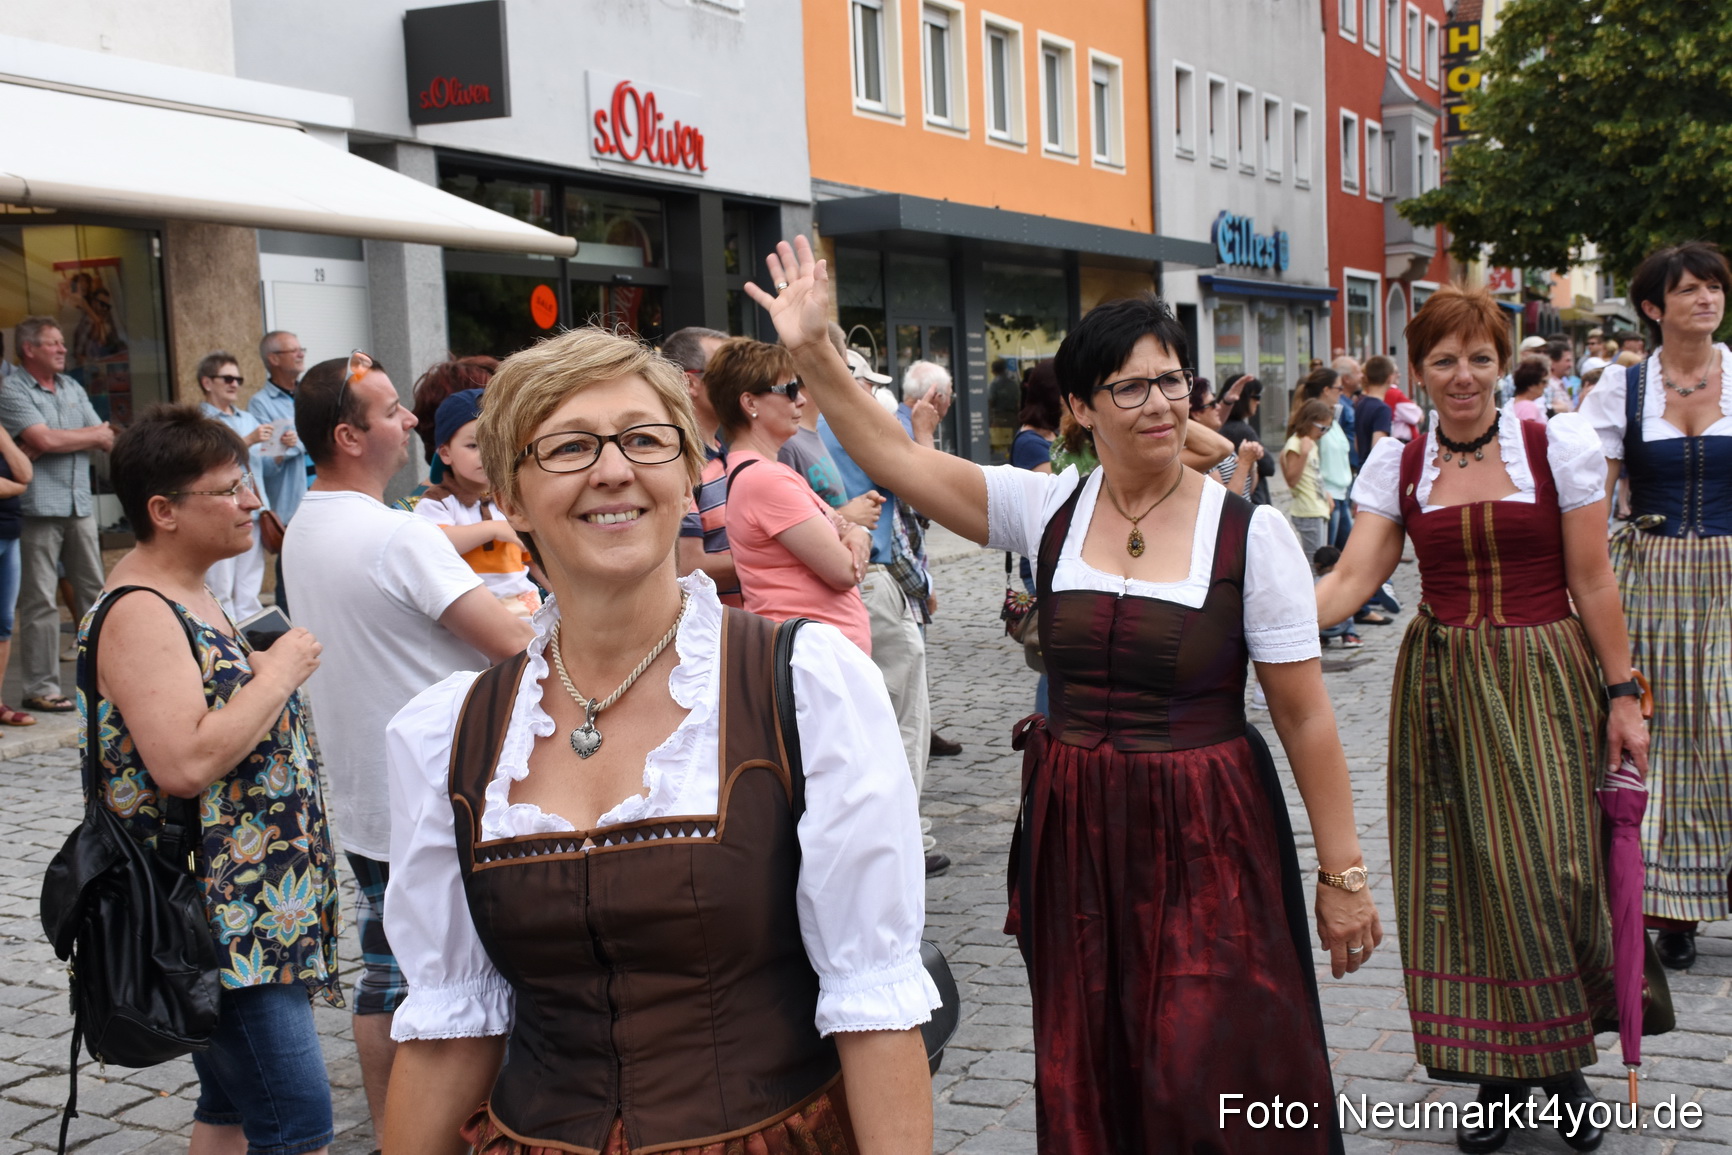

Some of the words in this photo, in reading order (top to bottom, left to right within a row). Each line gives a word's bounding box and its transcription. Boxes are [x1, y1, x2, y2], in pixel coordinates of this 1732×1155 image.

[420, 76, 493, 109] s.Oliver
[594, 80, 708, 171] s.Oliver
[1213, 210, 1276, 268] Eilles
[314, 268, 325, 282] 29
